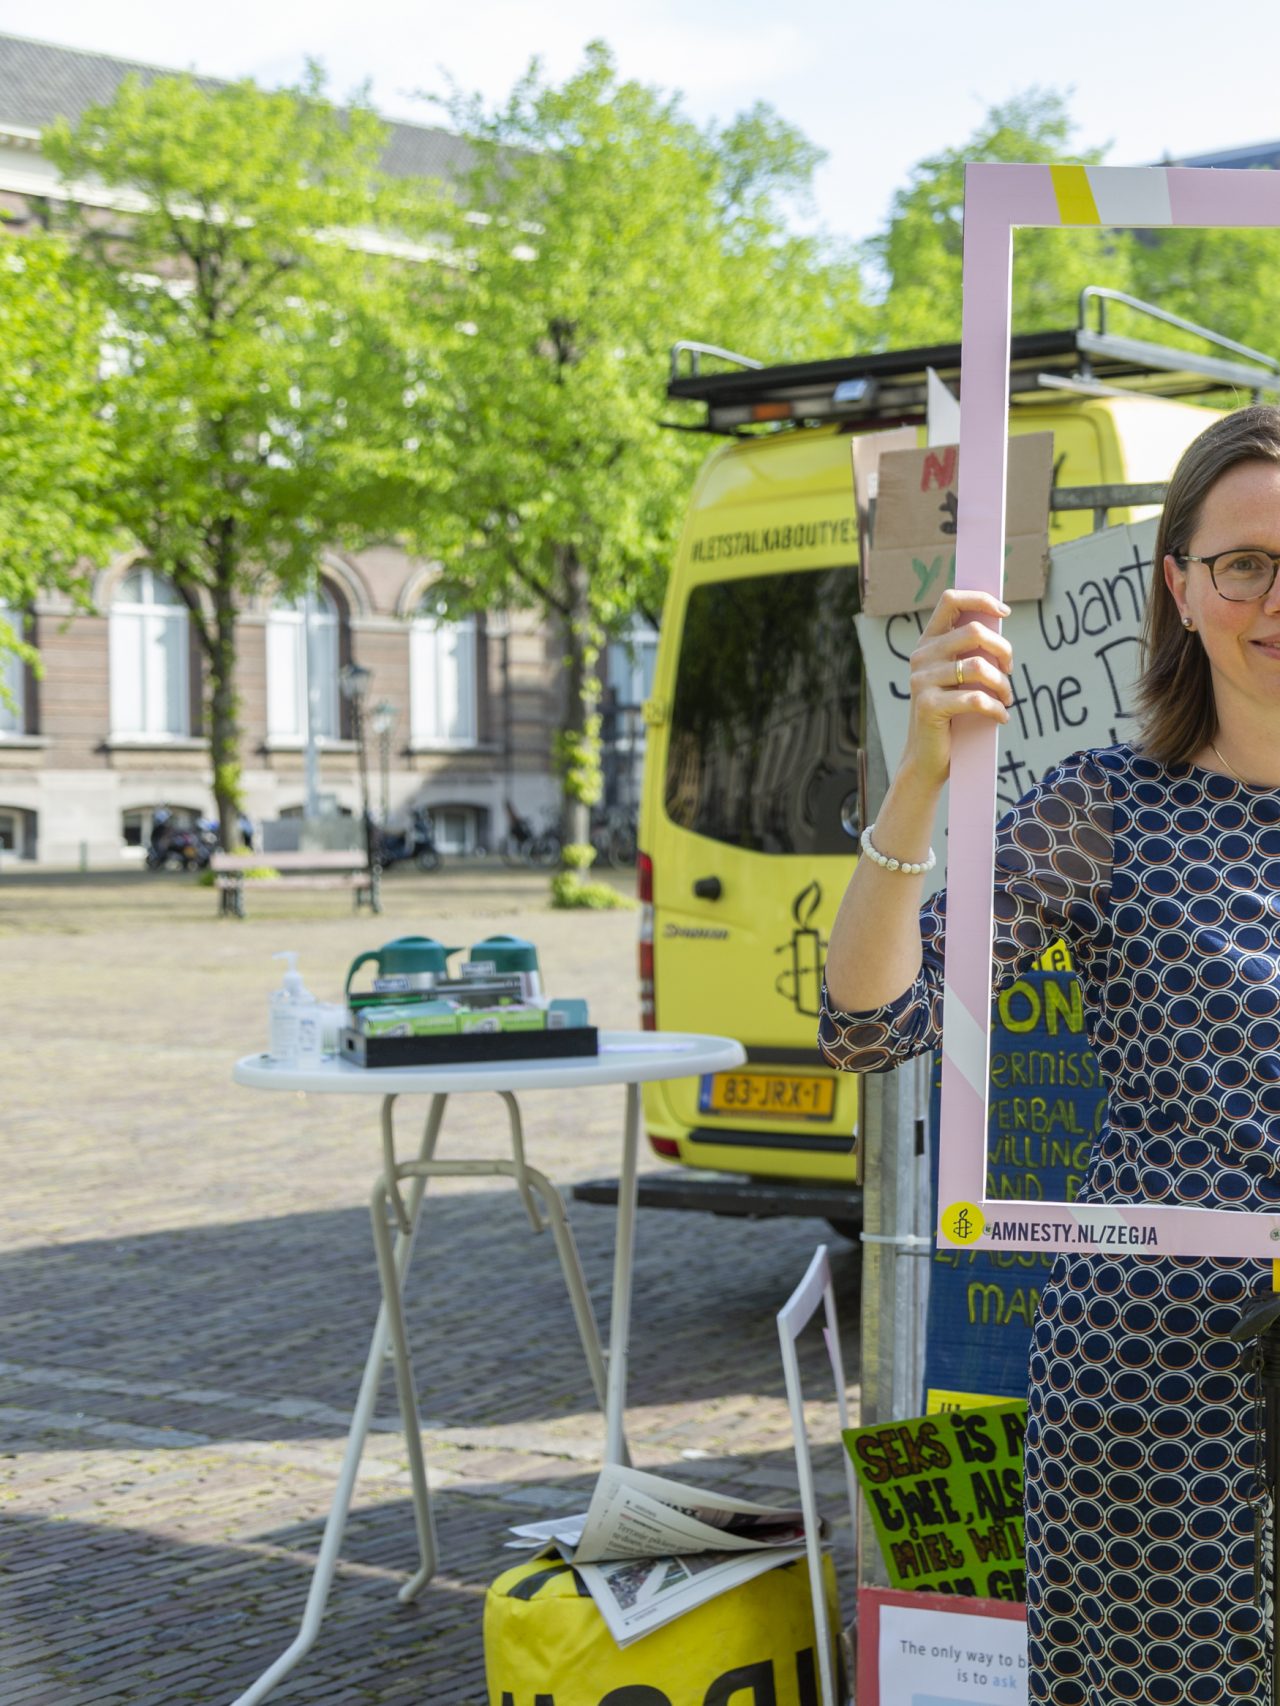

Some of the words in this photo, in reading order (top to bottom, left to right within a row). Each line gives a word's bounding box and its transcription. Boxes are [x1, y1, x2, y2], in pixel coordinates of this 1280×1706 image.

[1006, 662, 1088, 740] the
[991, 979, 1085, 1036] ON
[991, 1221, 1158, 1246] AMNESTY.NL/ZEGJA
[855, 1421, 952, 1484] SEKS
[900, 1639, 927, 1656] The
[931, 1644, 962, 1663] only
[966, 1653, 993, 1668] way
[999, 1653, 1013, 1668] to
[957, 1668, 969, 1683] is
[973, 1669, 988, 1686] to
[993, 1674, 1018, 1690] ask
